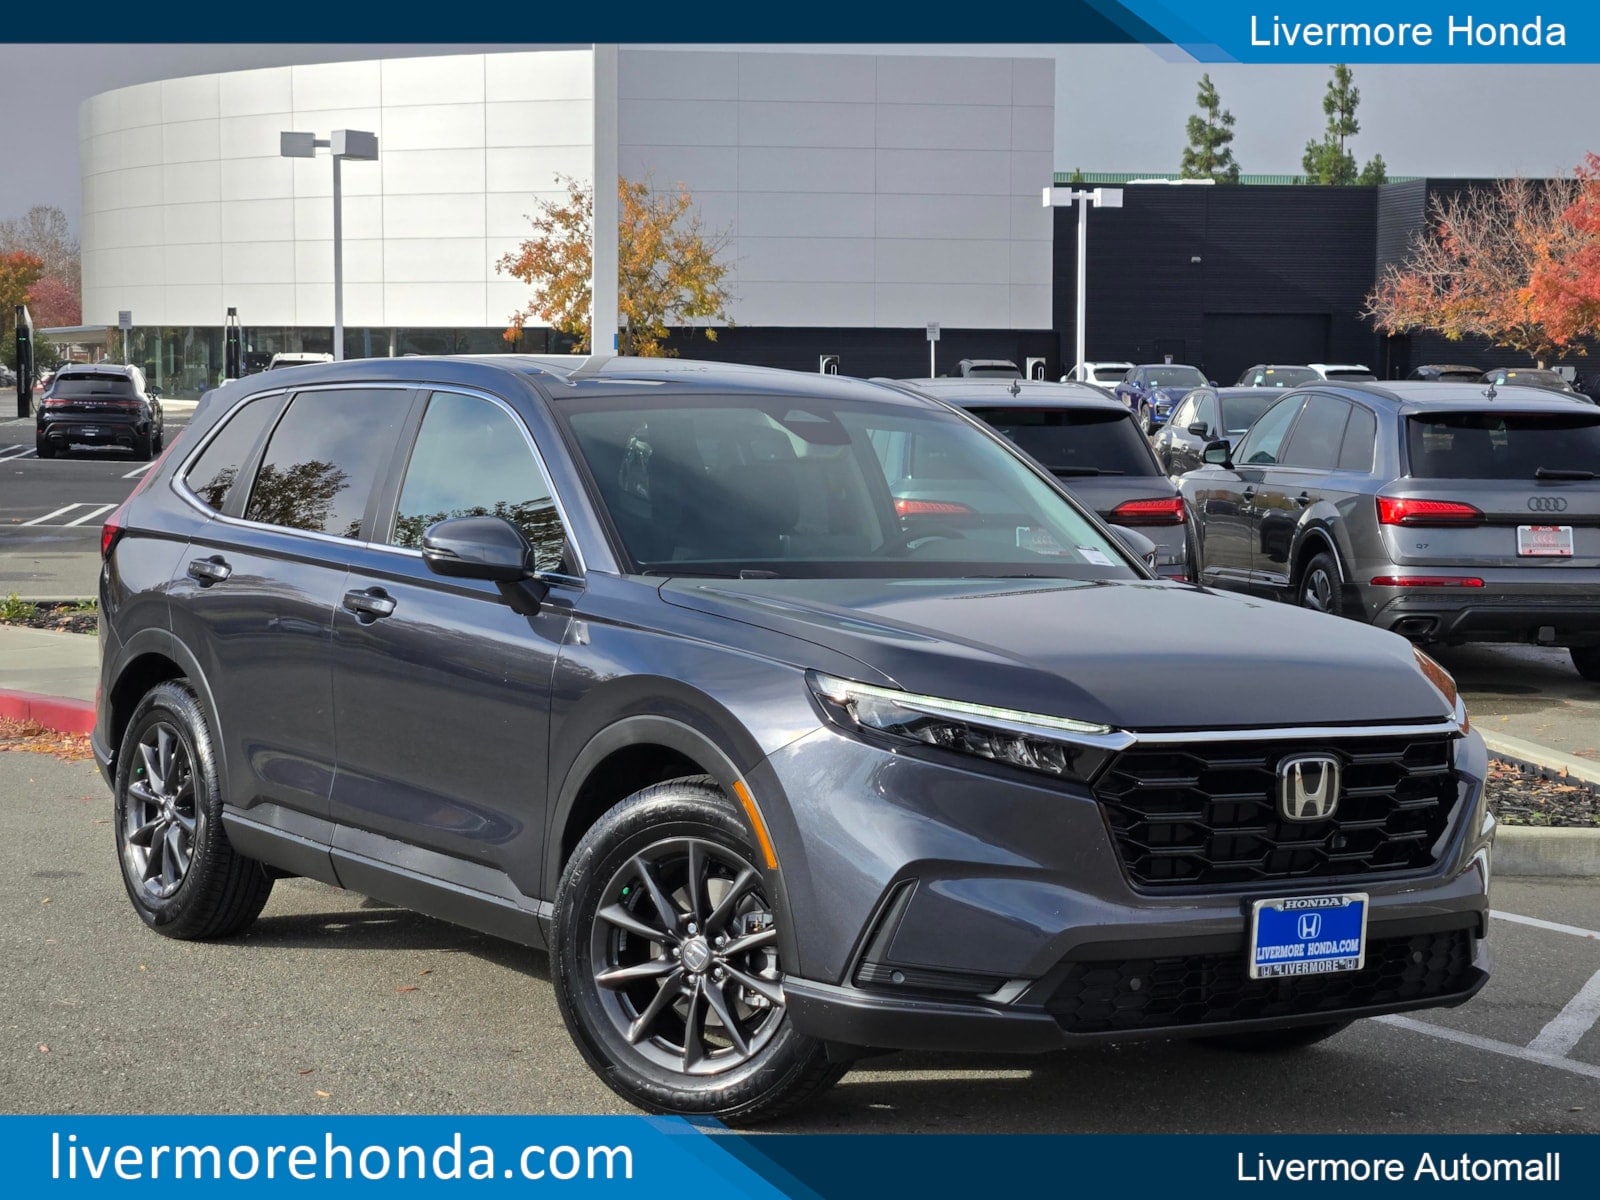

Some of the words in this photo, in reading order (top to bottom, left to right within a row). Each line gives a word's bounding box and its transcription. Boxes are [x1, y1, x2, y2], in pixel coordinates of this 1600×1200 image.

[1285, 898, 1340, 909] HONDA
[1257, 943, 1305, 960] LIVERMORE
[1308, 939, 1359, 956] HONDA.COM
[1279, 960, 1339, 975] LIVERMORE
